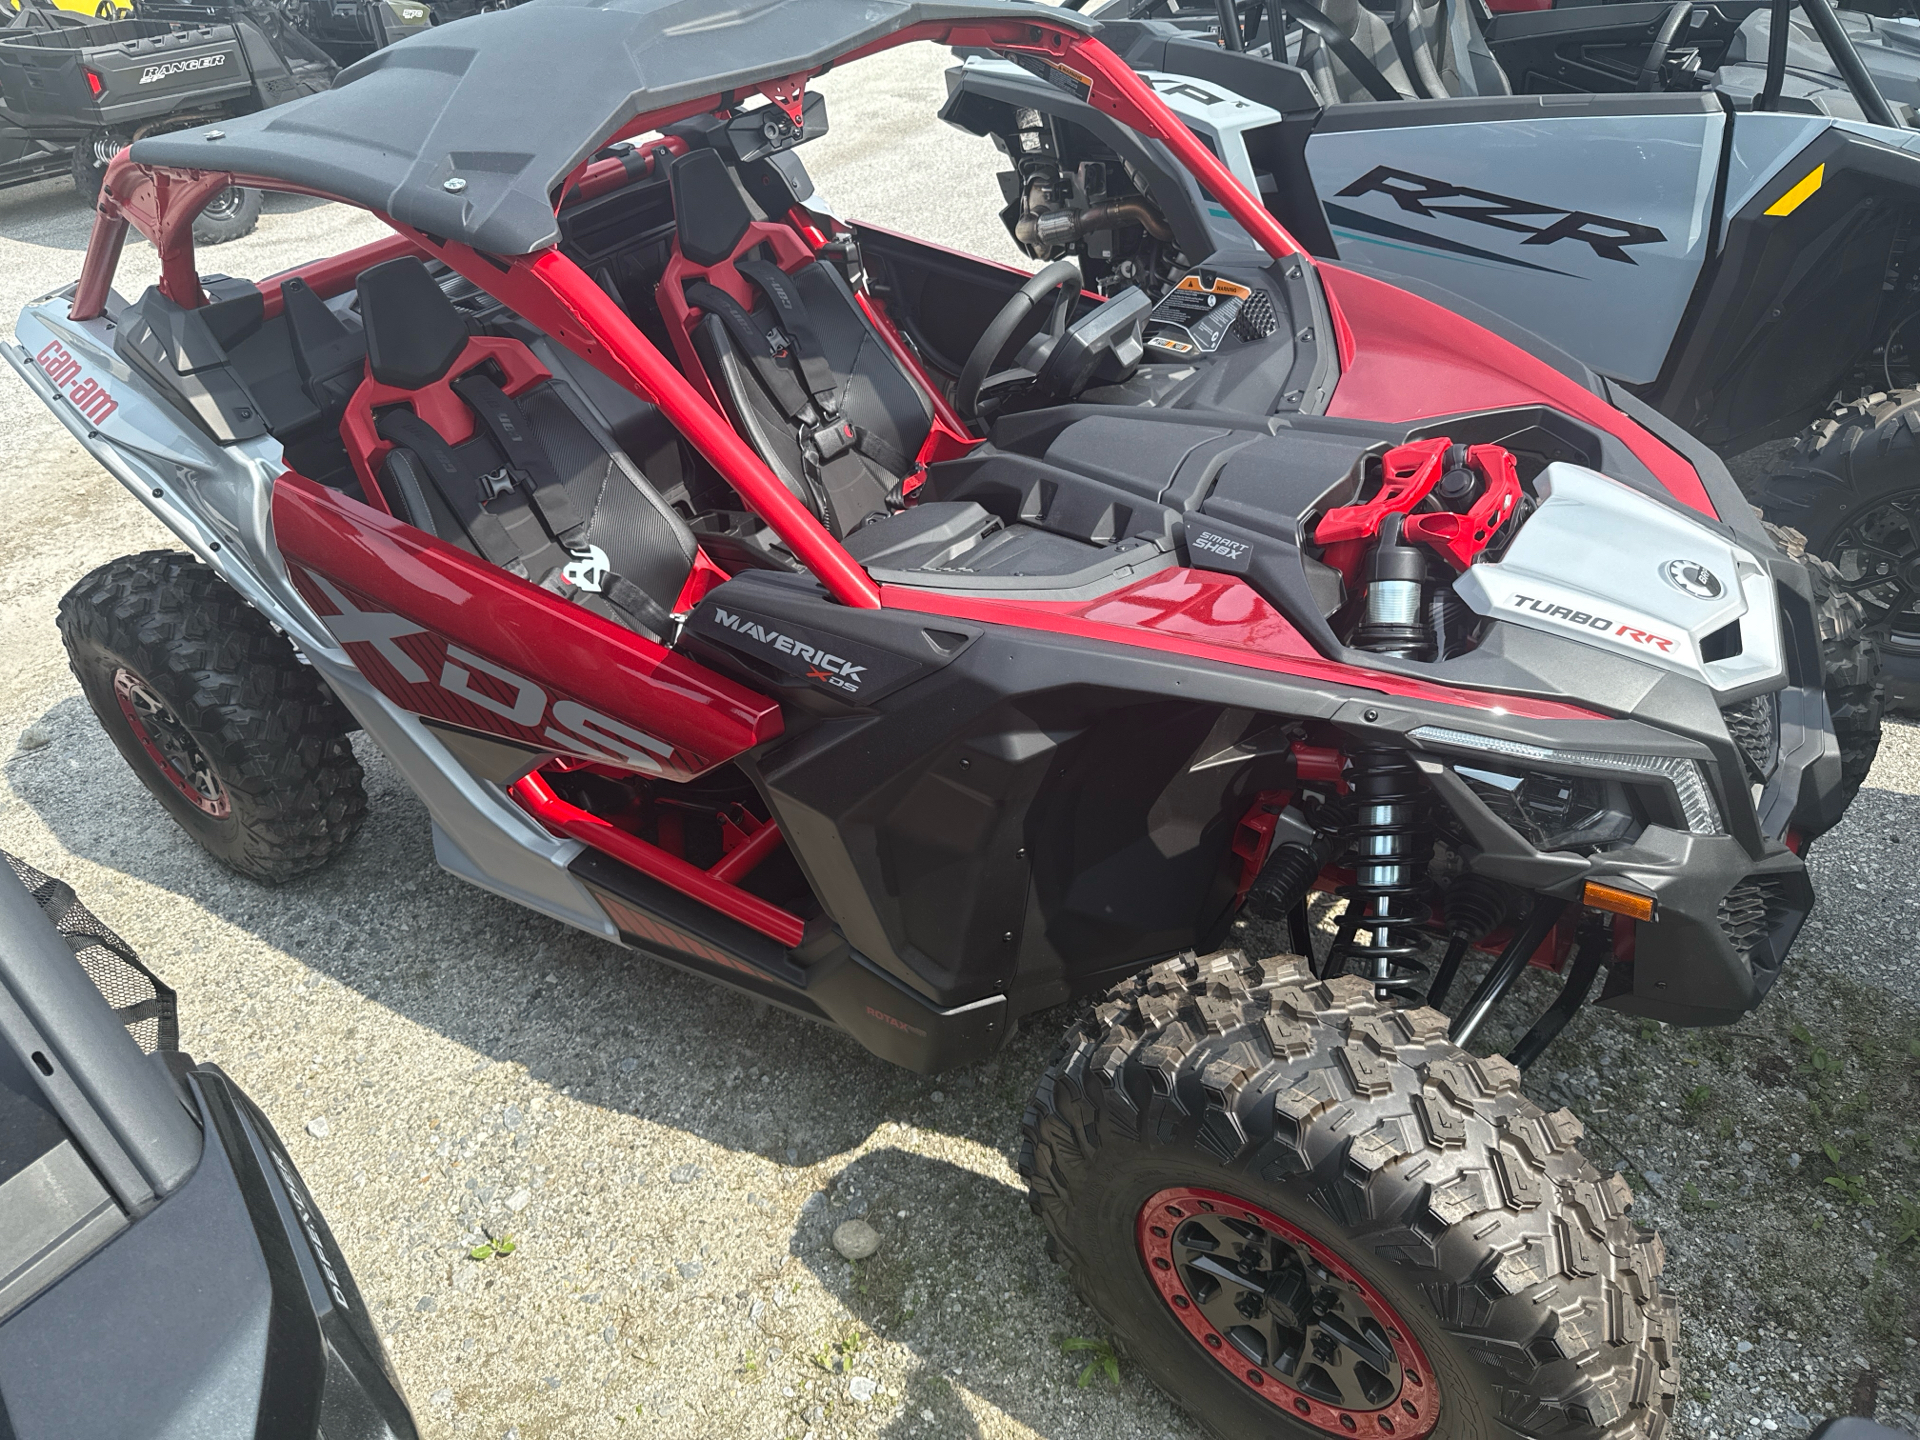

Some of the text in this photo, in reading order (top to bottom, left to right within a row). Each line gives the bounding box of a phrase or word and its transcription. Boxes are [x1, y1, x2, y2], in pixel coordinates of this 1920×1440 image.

[143, 55, 225, 78] RANGER
[1333, 165, 1668, 266] RZR
[1216, 285, 1237, 293] WARNING
[36, 340, 119, 426] can-am
[1200, 531, 1249, 551] SMART
[714, 607, 868, 683] MAVERICK
[1514, 594, 1674, 653] TURBO RR
[865, 1006, 908, 1033] ROTAX
